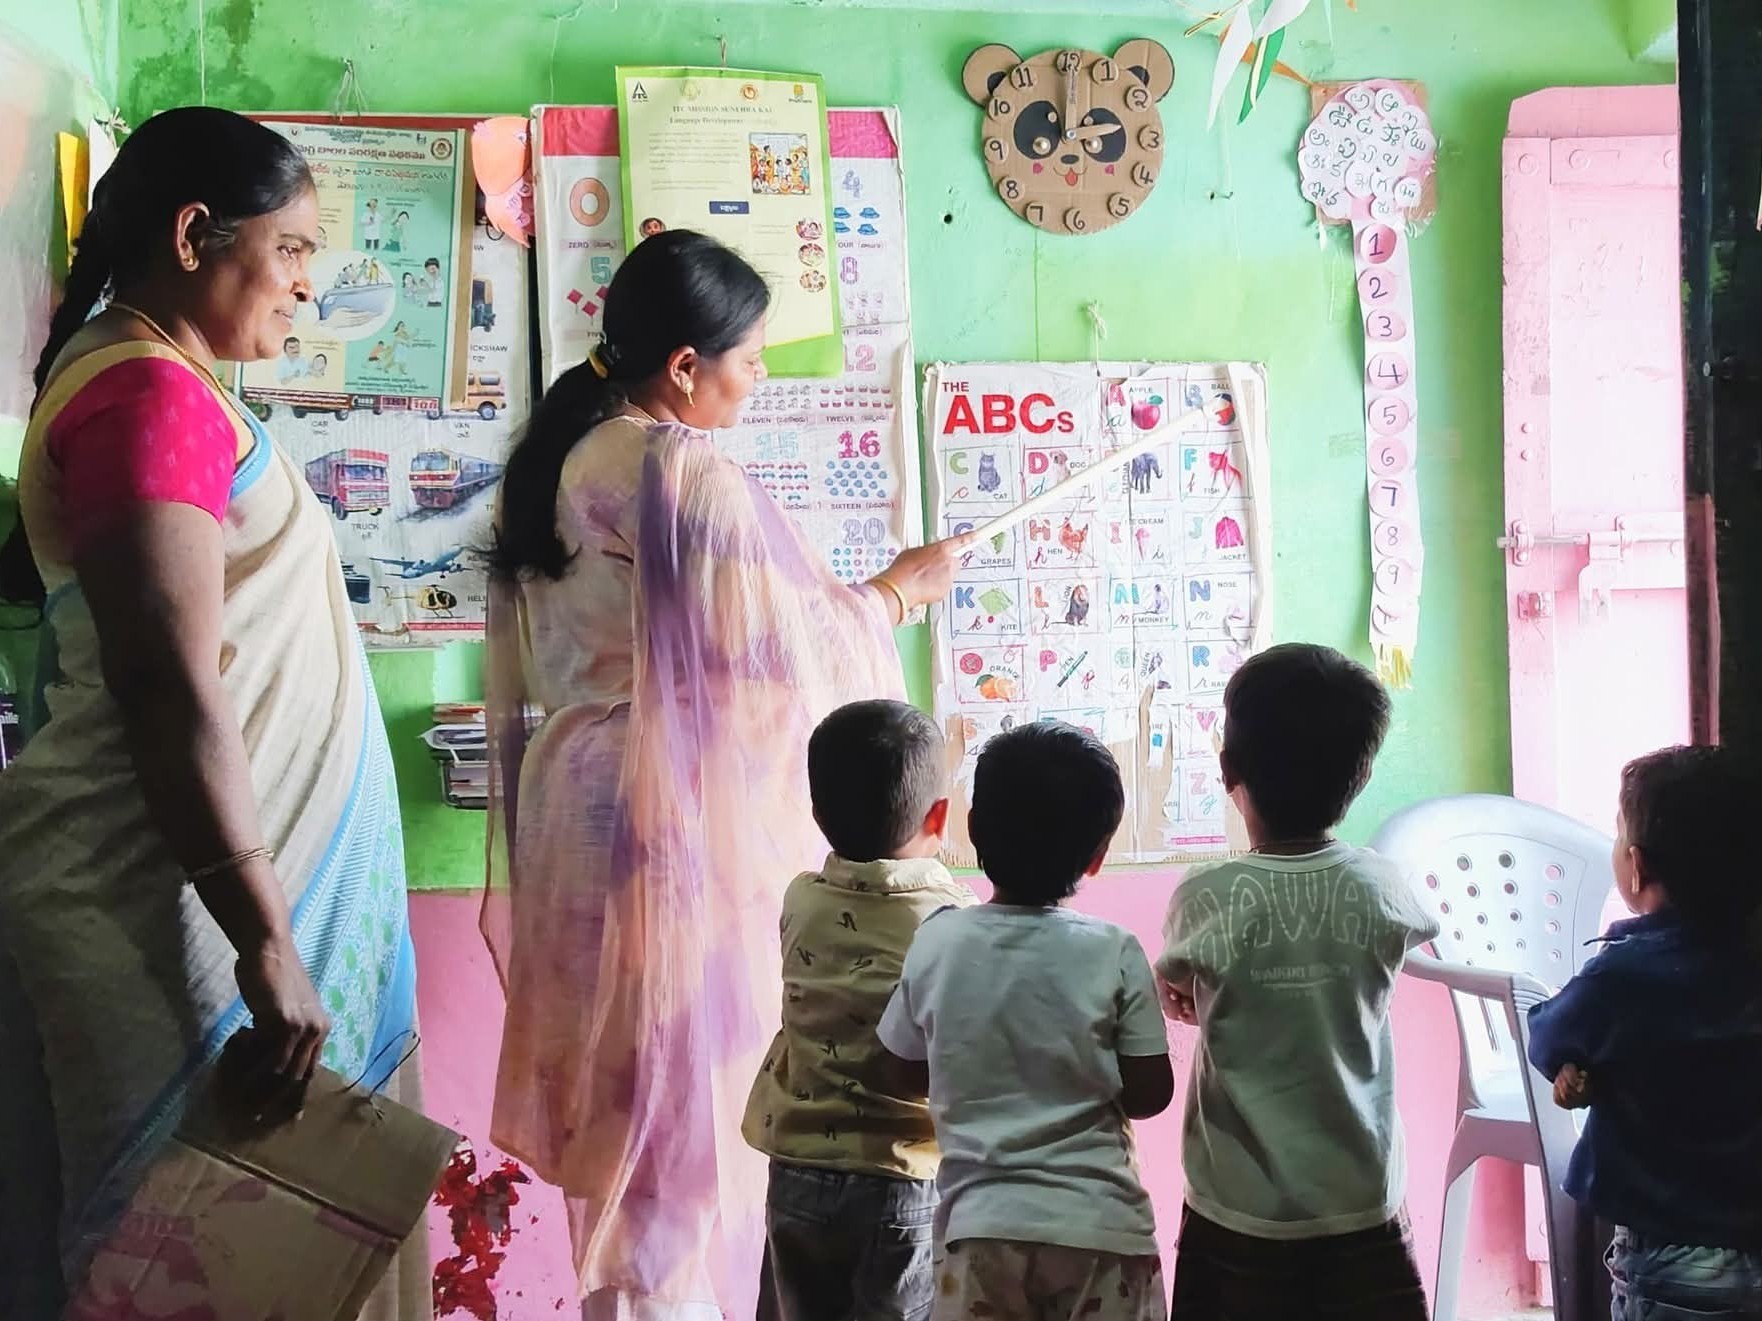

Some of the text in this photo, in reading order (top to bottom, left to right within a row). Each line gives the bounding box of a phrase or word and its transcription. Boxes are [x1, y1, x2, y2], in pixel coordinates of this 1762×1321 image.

[1061, 52, 1080, 73] 12
[1101, 61, 1114, 82] 1
[1018, 67, 1034, 88] 11
[994, 99, 1010, 116] 10
[1132, 91, 1148, 109] 2
[990, 140, 1004, 160] 9
[1147, 131, 1160, 149] 3
[1139, 166, 1154, 185] 4
[1006, 180, 1019, 199] 8
[1030, 206, 1044, 222] 7
[1115, 198, 1130, 217] 5
[1073, 210, 1086, 230] 6
[838, 241, 854, 249] OUR
[1369, 233, 1384, 257] 1
[590, 256, 612, 285] 5
[1369, 276, 1388, 299] 2
[1378, 316, 1393, 337] 3
[470, 344, 508, 352] ICKSHAW
[1378, 359, 1402, 384] 4
[942, 381, 970, 392] THE
[1106, 383, 1125, 407] A
[742, 416, 771, 424] ELEVEN
[826, 415, 855, 423] TWELVE
[943, 393, 1075, 434] ABCs
[1383, 405, 1397, 425] 5
[755, 431, 800, 460] 15
[838, 429, 881, 459] 16
[949, 452, 969, 475] C
[1028, 452, 1049, 474] D
[1184, 448, 1198, 470] F
[1381, 448, 1395, 466] 6
[831, 502, 861, 510] SIXTEEN
[1381, 486, 1398, 507] 7
[842, 517, 886, 546] 20
[1029, 519, 1051, 541] H
[1189, 517, 1203, 539] J
[1387, 526, 1399, 546] 8
[1388, 564, 1400, 585] 9
[955, 586, 975, 608] K
[1034, 586, 1049, 608] L
[1189, 580, 1211, 602] N
[1040, 650, 1057, 672] P
[1192, 645, 1210, 668] R
[990, 665, 1020, 680] ORANG
[1197, 711, 1216, 732] V
[1190, 773, 1208, 795] Z
